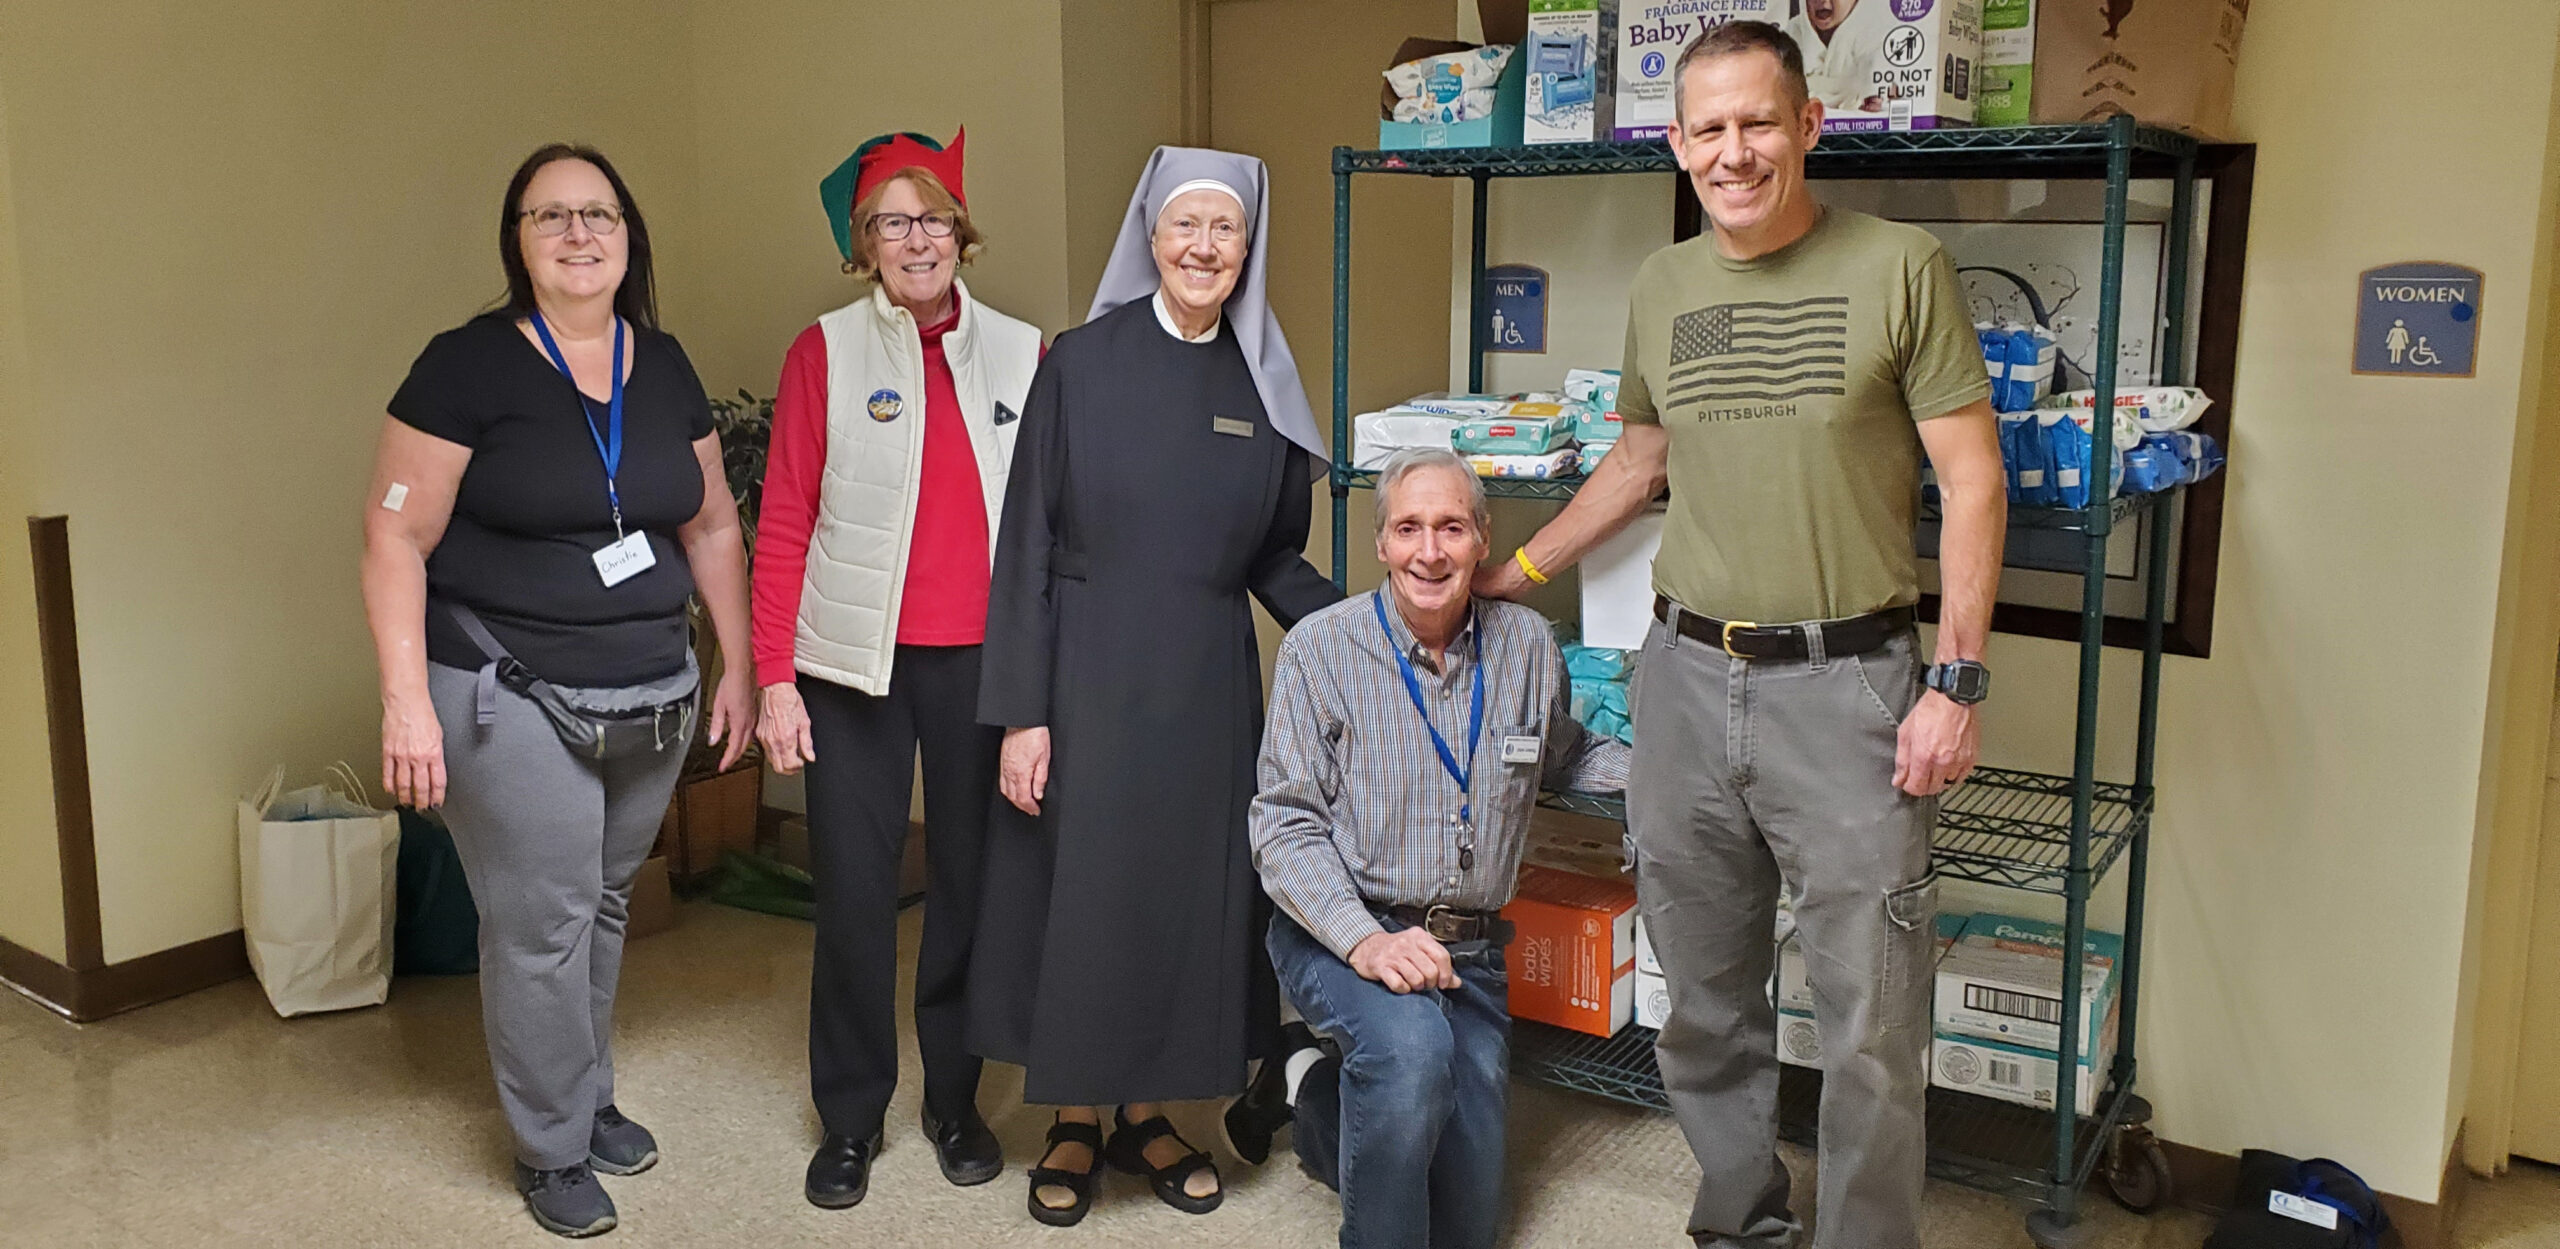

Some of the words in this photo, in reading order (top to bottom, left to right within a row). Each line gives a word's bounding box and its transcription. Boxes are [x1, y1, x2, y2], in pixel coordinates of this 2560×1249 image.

[1645, 0, 1728, 19] FRAGRANCE
[1732, 0, 1766, 11] FREE
[1629, 17, 1691, 47] Baby
[1873, 70, 1895, 83] DO
[1901, 69, 1932, 83] NOT
[1878, 85, 1925, 99] FLUSH
[1866, 120, 1883, 130] WIPES
[1496, 284, 1524, 296] MEN
[2376, 286, 2465, 302] WOMEN
[2084, 394, 2144, 407] HGIES
[1698, 405, 1797, 422] PITTSBURGH
[1522, 936, 1540, 982] baby
[1540, 937, 1552, 987] wipes
